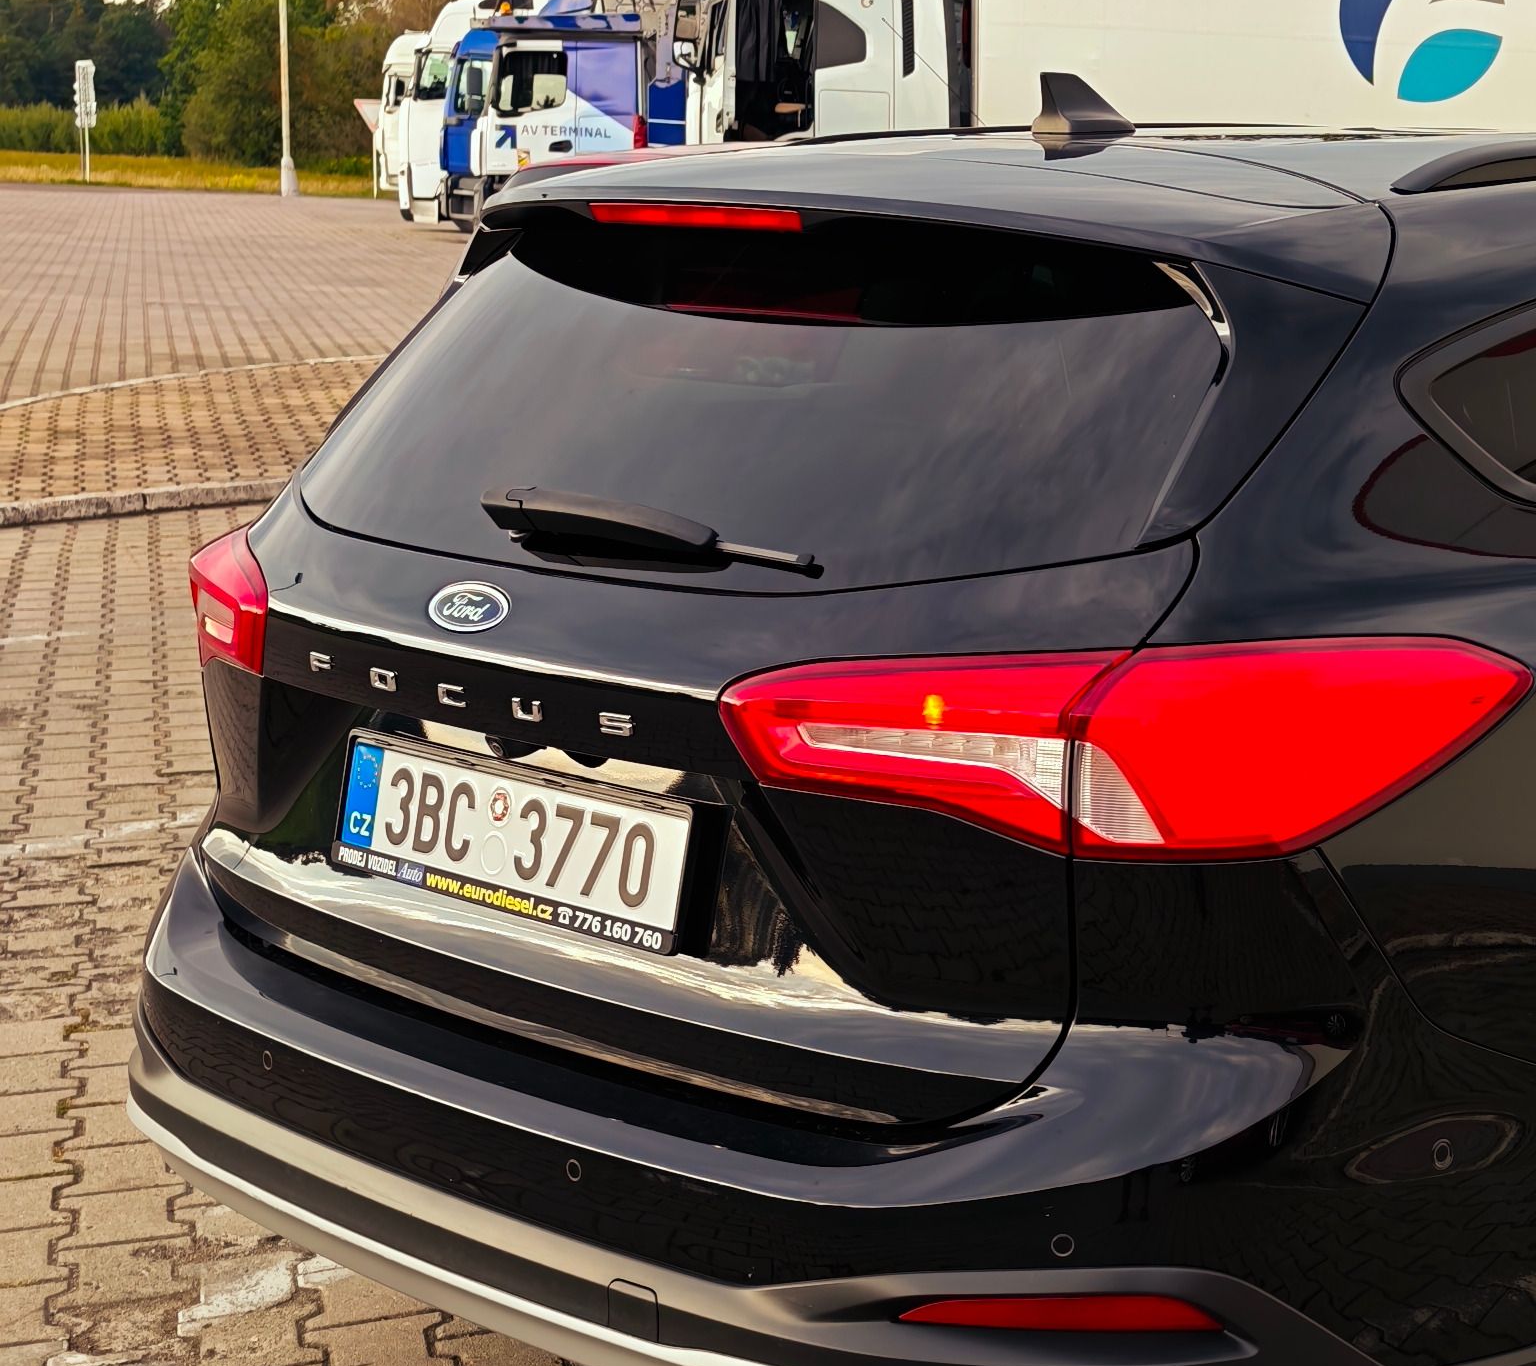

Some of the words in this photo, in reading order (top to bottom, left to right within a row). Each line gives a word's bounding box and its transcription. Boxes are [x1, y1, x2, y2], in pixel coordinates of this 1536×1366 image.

[521, 124, 538, 136] AV
[542, 125, 611, 139] TERMINAL
[443, 592, 491, 621] Ford
[309, 651, 635, 737] FOCUS
[349, 810, 372, 837] CZ
[385, 767, 476, 862] 3BC
[514, 798, 656, 908] 3770
[338, 846, 367, 868] PRODEJ
[367, 854, 397, 876] VOZIDEL
[398, 862, 423, 882] Auto
[426, 872, 553, 921] www.eurodiesel.cz
[574, 911, 602, 933] 776
[603, 919, 631, 942] 160
[633, 927, 662, 950] 760
